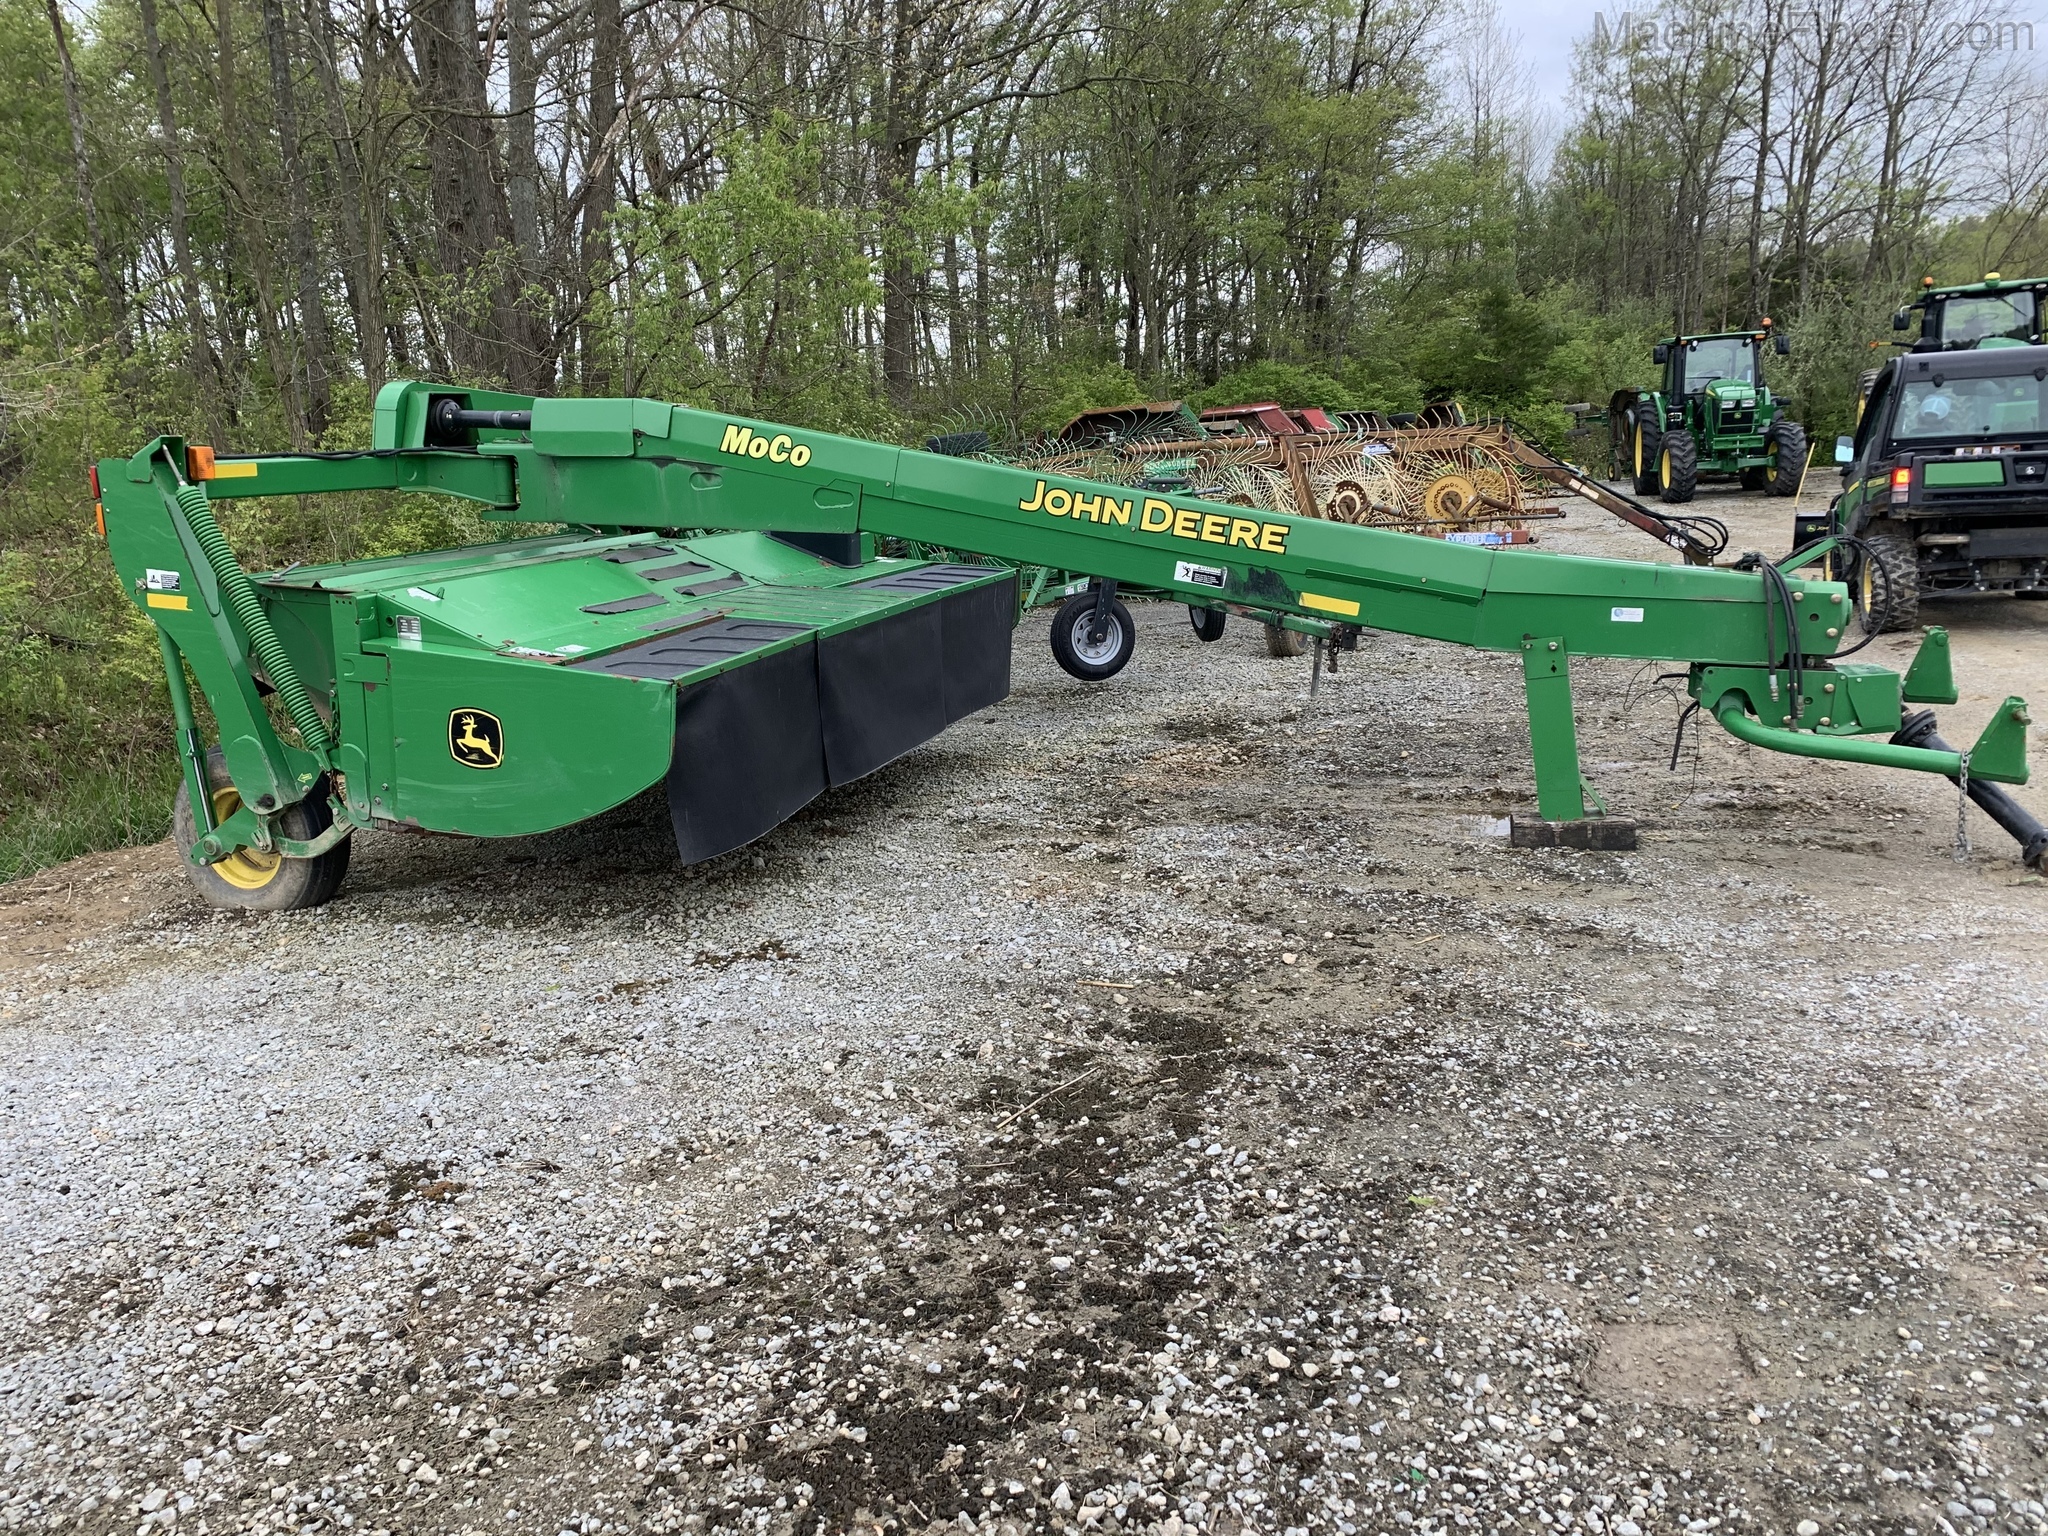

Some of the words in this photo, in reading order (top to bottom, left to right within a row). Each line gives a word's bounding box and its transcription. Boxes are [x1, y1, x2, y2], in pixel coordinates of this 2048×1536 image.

[719, 423, 812, 467] MoCo
[1019, 479, 1133, 526] JOHN
[1139, 497, 1290, 554] DEERE
